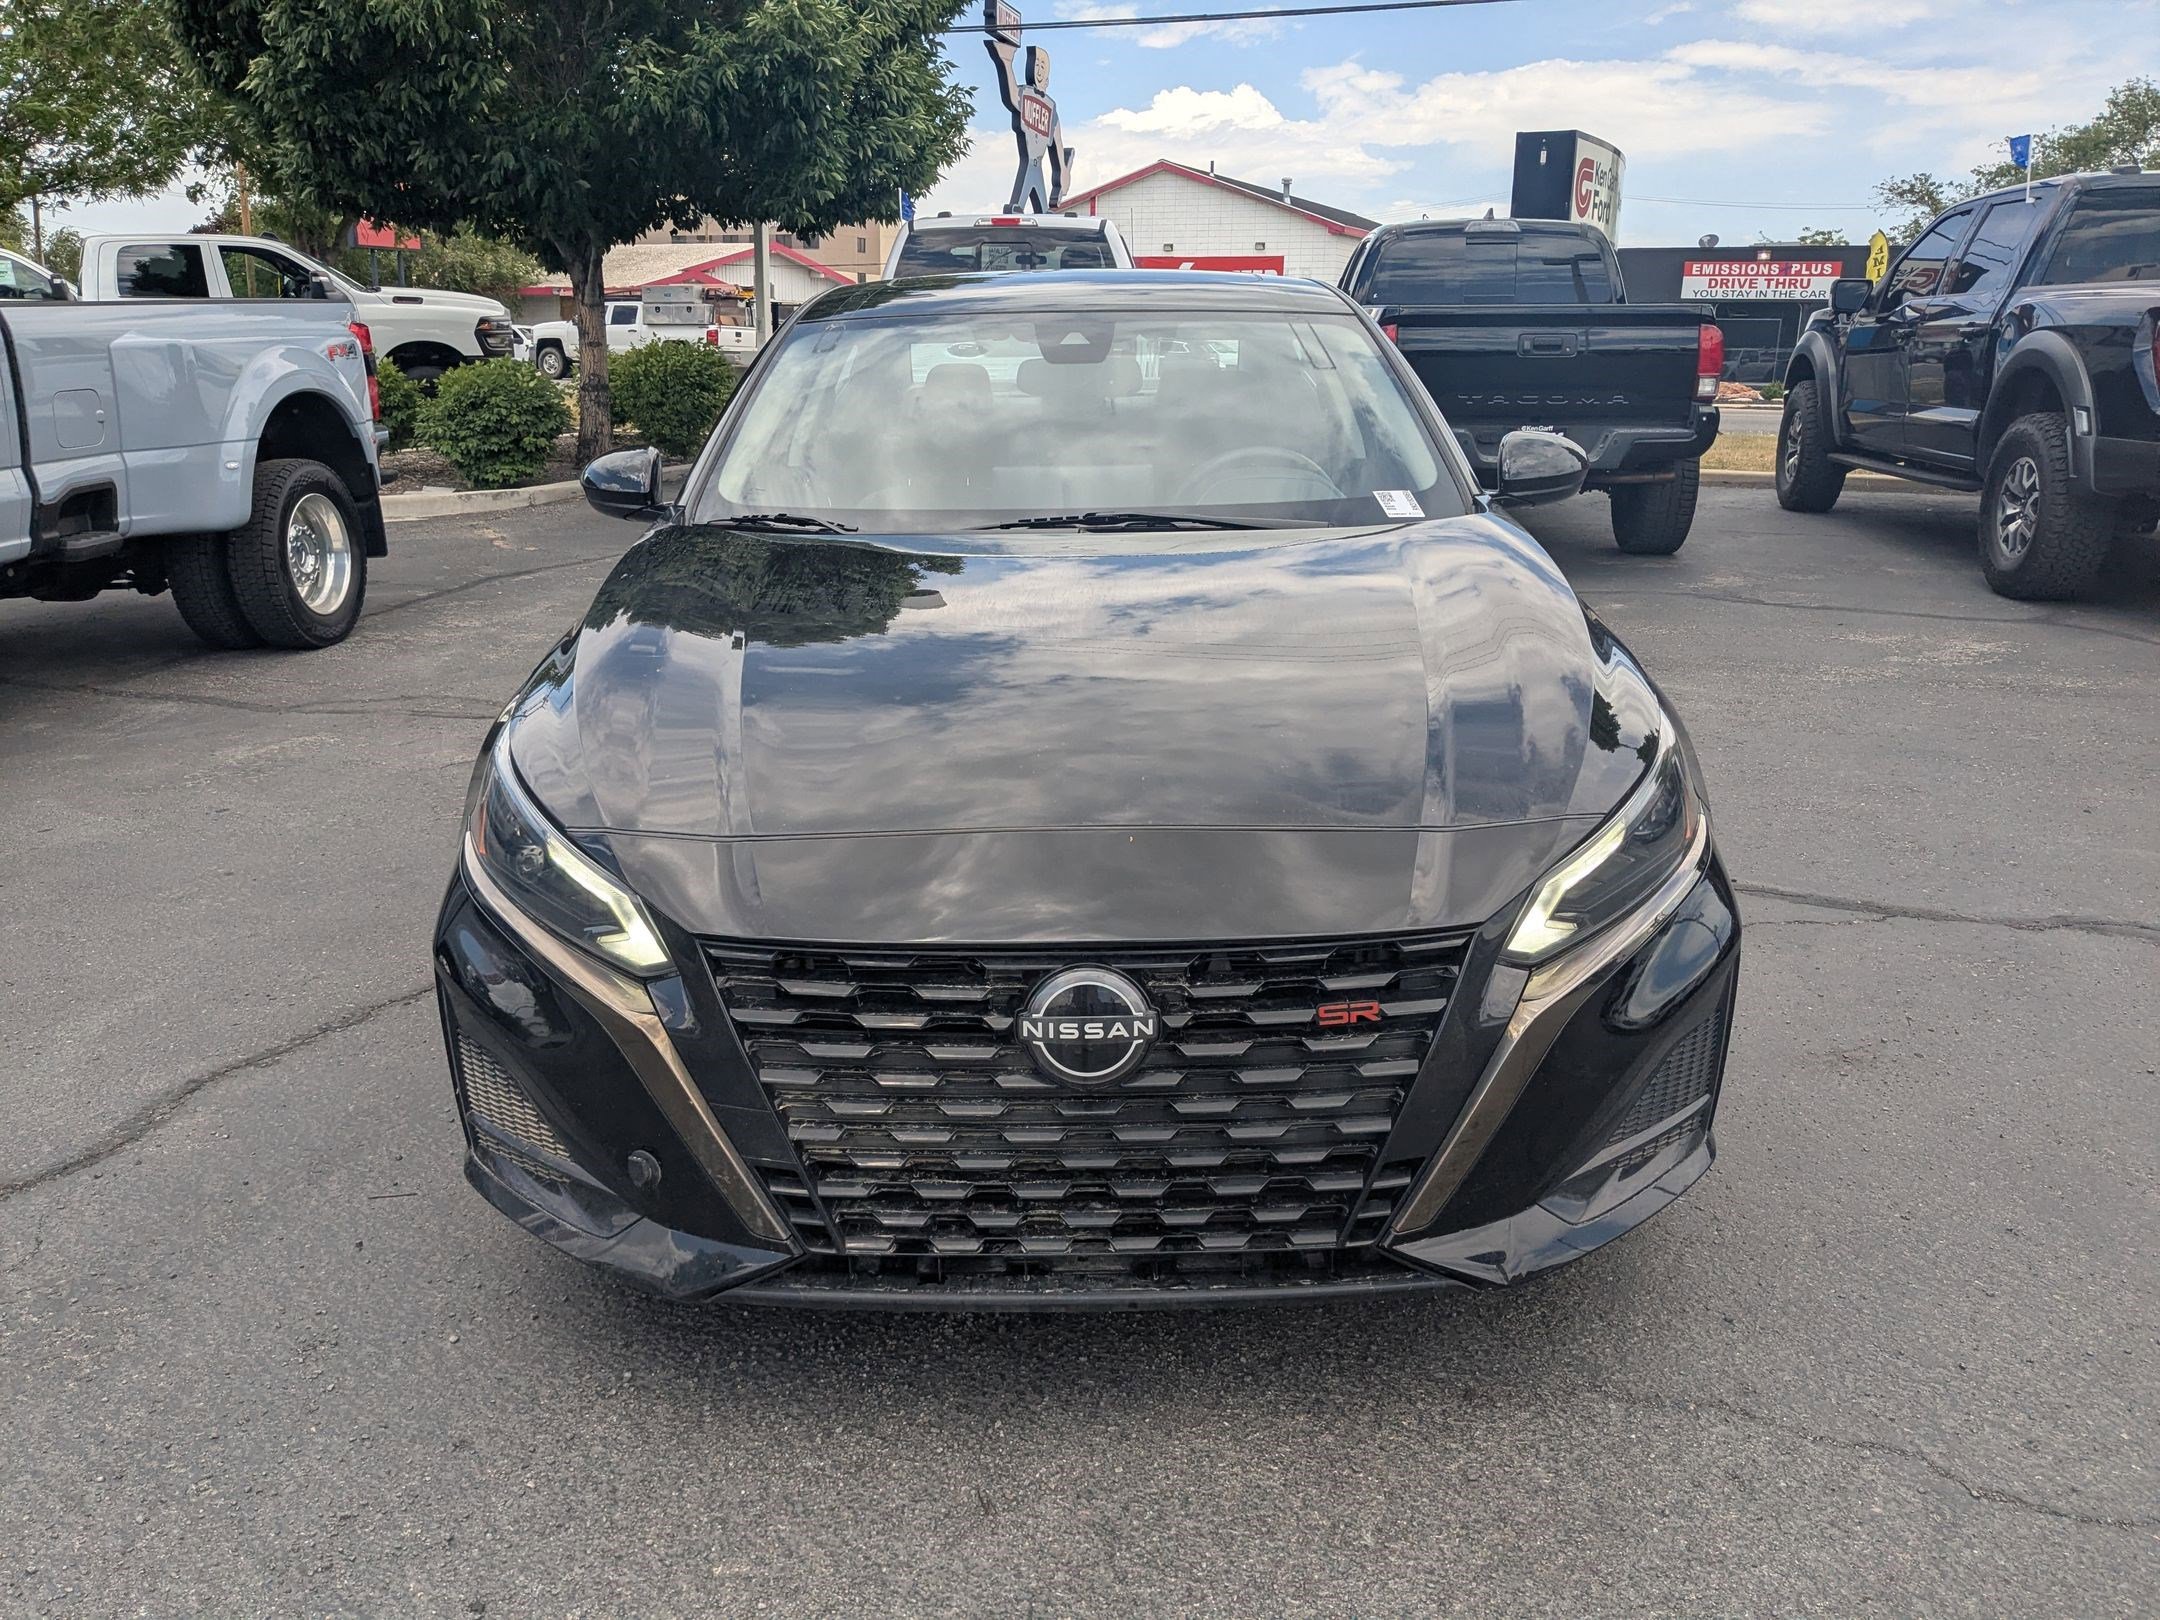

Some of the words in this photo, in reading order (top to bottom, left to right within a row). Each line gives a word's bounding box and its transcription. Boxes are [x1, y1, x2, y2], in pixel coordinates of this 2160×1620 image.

[1024, 98, 1049, 133] MUFFLER
[1595, 161, 1607, 188] Ken
[1591, 189, 1611, 224] Ford
[1691, 263, 1779, 275] EMISSIONS
[1791, 263, 1833, 275] PLUS
[1707, 278, 1758, 289] DRIVE
[1764, 278, 1811, 289] THRU
[1692, 290, 1718, 298] YOU
[1721, 290, 1754, 298] STAY
[1755, 290, 1768, 298] IN
[1771, 290, 1797, 298] THE
[1800, 290, 1827, 298] CAR
[327, 343, 358, 361] FX4
[1458, 395, 1630, 404] TACOMA
[1317, 1001, 1381, 1027] SR
[1022, 1019, 1154, 1040] NISSAN
